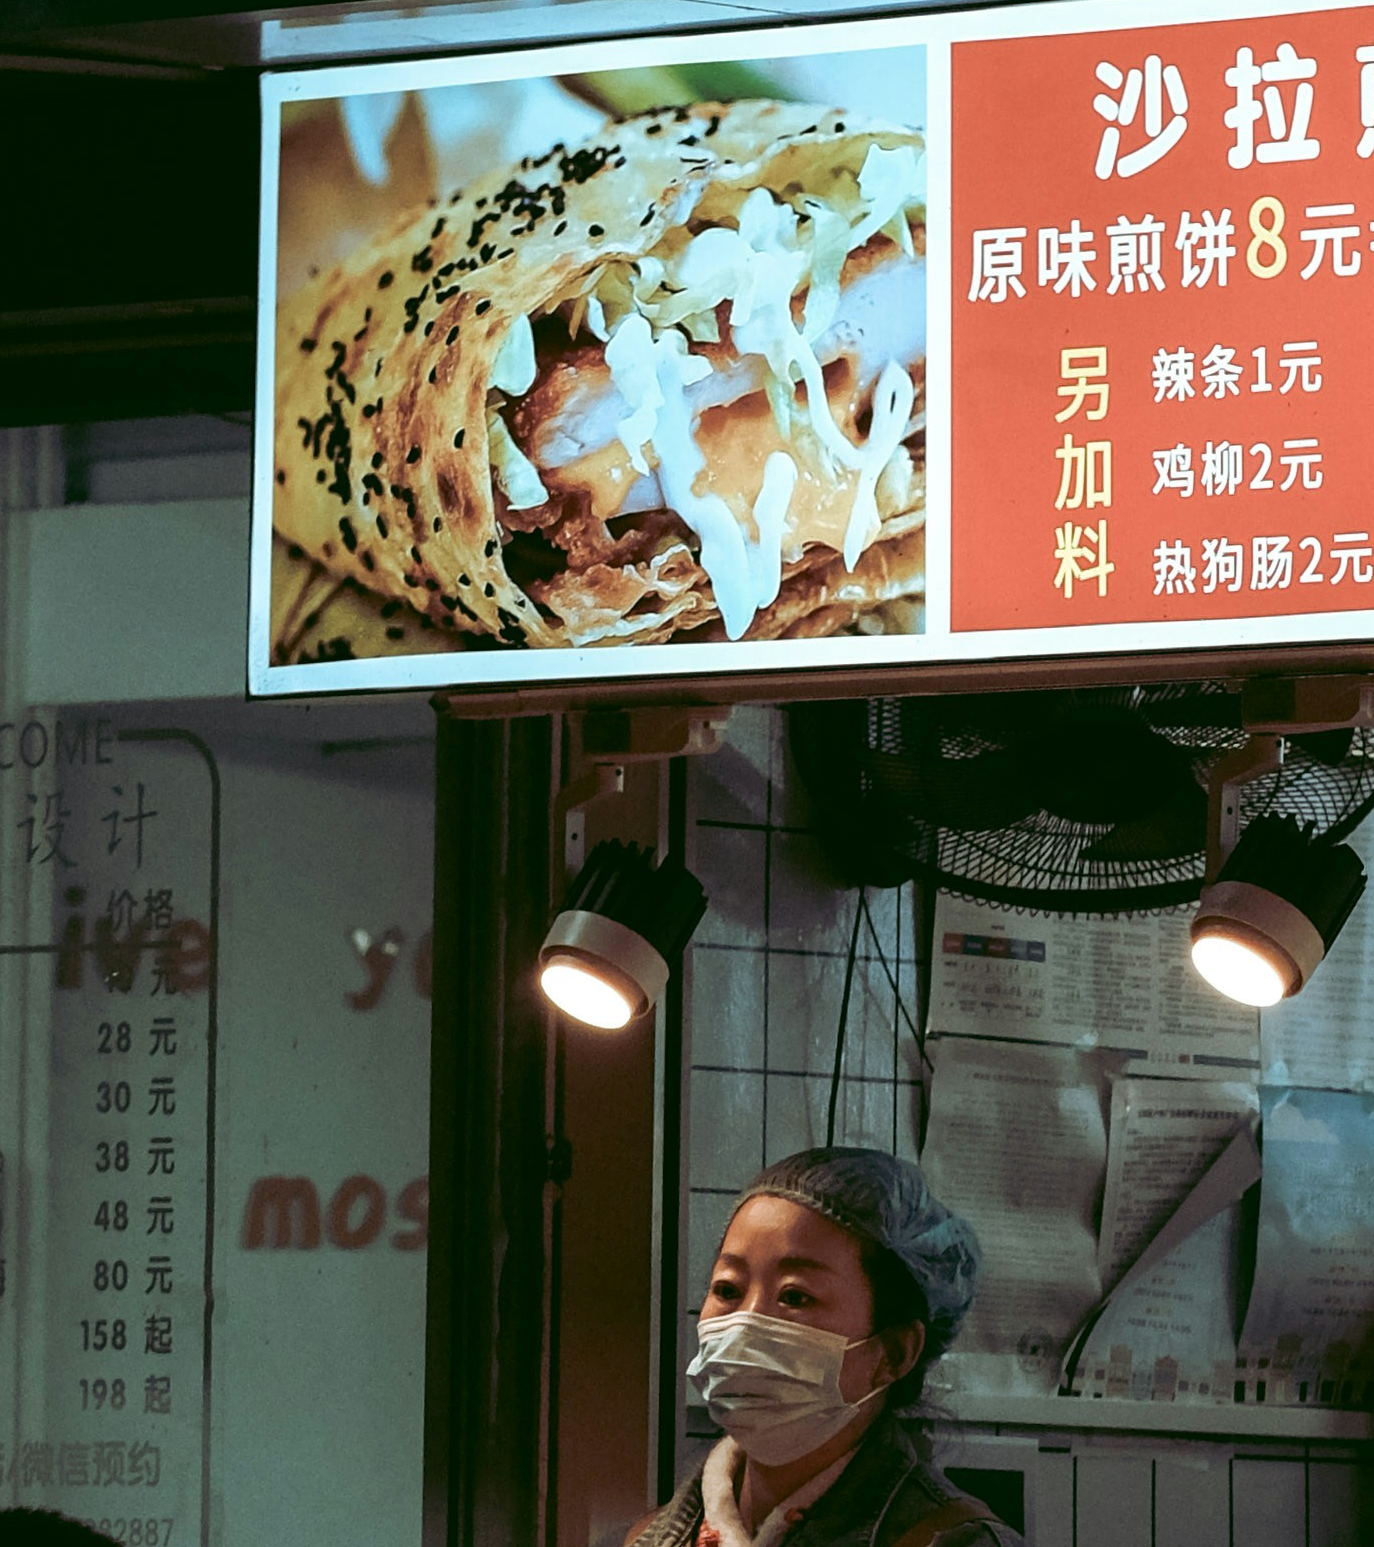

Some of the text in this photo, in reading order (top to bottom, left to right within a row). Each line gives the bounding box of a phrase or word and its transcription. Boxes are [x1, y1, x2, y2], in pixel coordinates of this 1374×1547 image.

[1152, 341, 1324, 403] 辣条1元
[1054, 345, 1114, 600] 另加料
[1152, 434, 1324, 500] 鸡柳2元
[1152, 529, 1374, 598] 热狗肠2元
[107, 887, 174, 935] 价格
